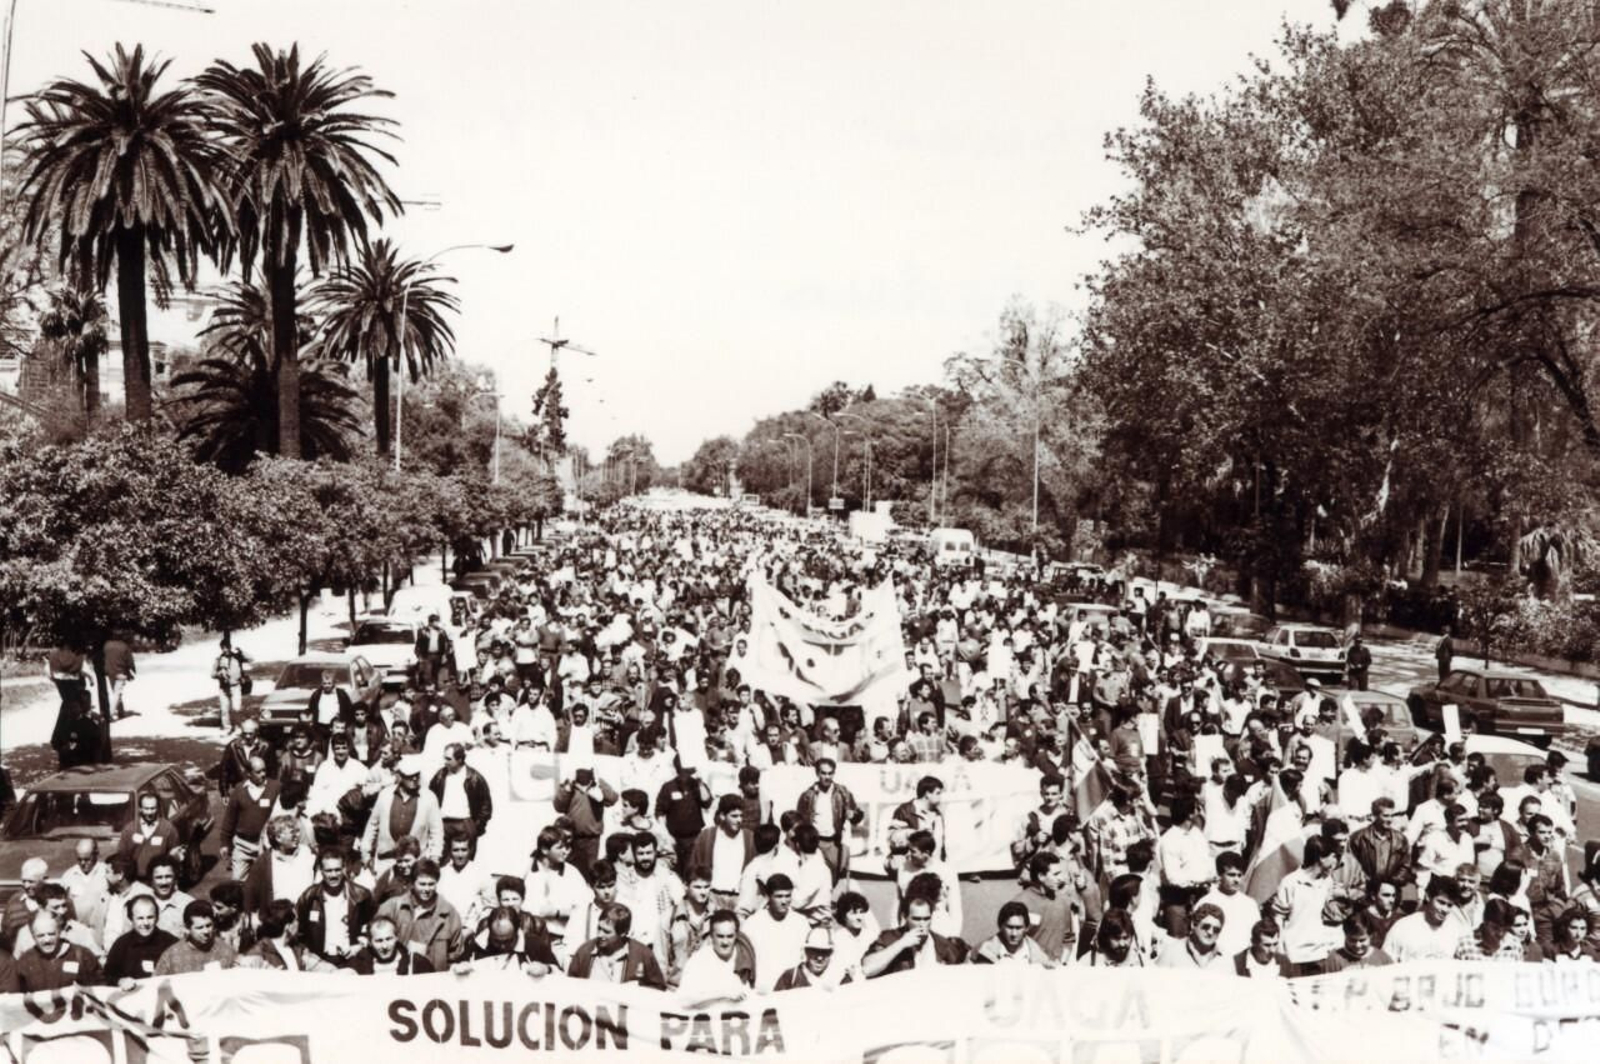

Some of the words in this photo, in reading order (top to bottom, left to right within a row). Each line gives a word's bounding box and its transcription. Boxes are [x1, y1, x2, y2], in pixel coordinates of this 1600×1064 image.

[387, 998, 629, 1051] SOLUCION
[660, 1007, 787, 1056] PARA
[983, 970, 1151, 1030] UAGA
